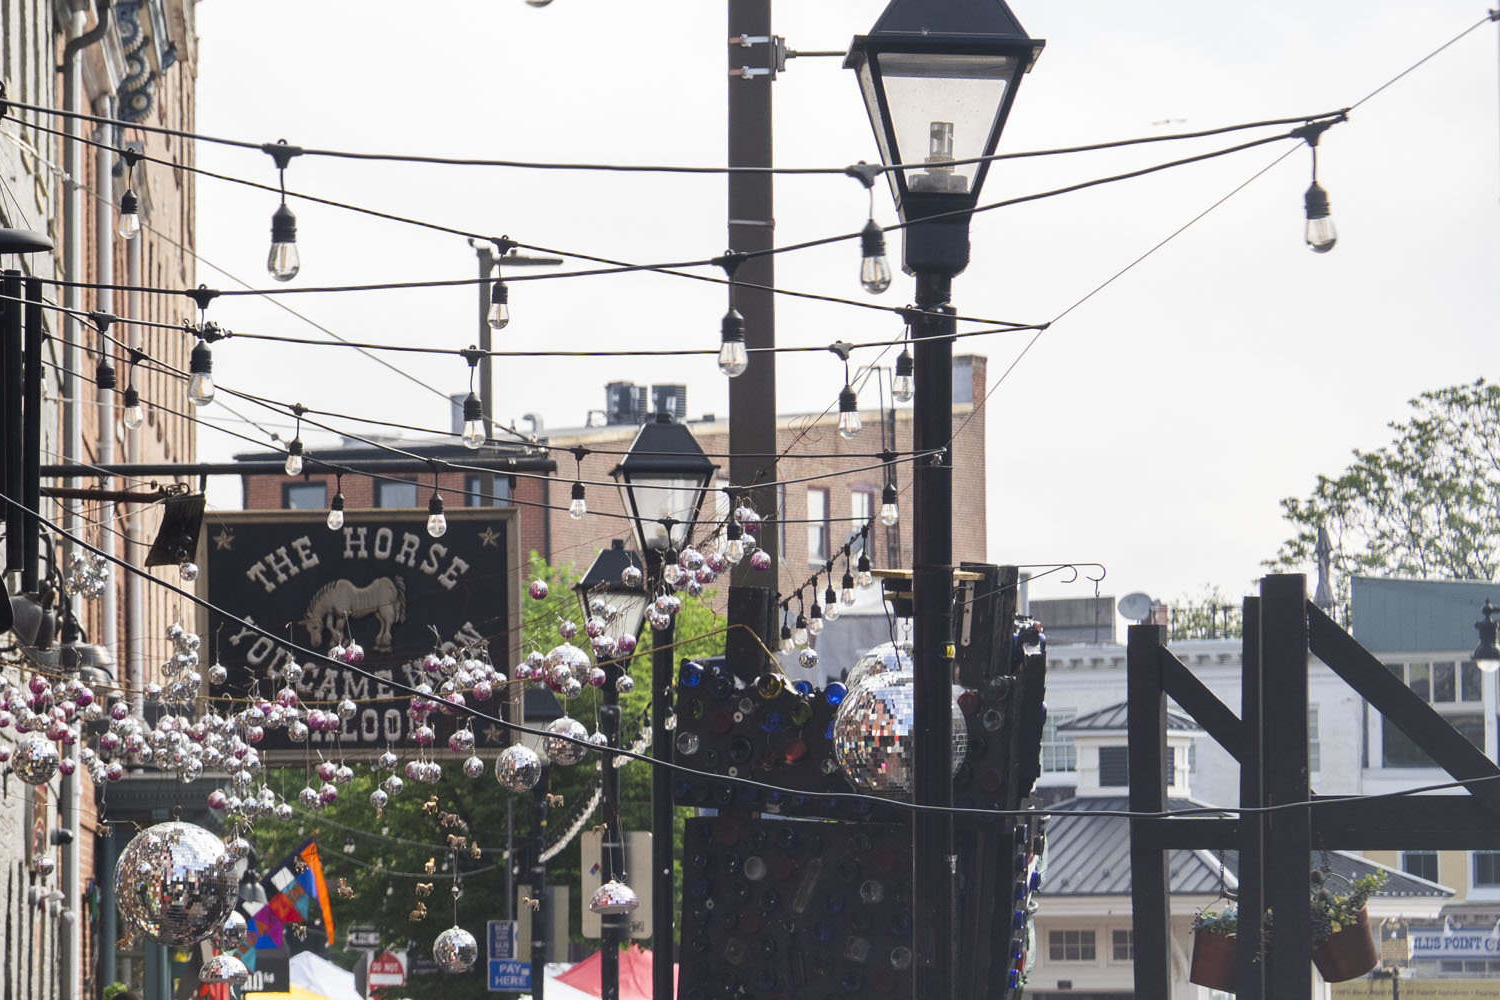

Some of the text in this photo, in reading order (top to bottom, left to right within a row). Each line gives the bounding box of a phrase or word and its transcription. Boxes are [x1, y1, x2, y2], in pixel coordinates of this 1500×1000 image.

[246, 526, 470, 593] THE HORSE
[229, 615, 289, 680] YOU
[298, 662, 395, 702] CAME
[298, 707, 436, 743] LOO
[1444, 936, 1482, 950] POINT
[373, 962, 399, 971] DO NOT
[499, 963, 521, 974] PAY
[495, 976, 526, 986] HERE
